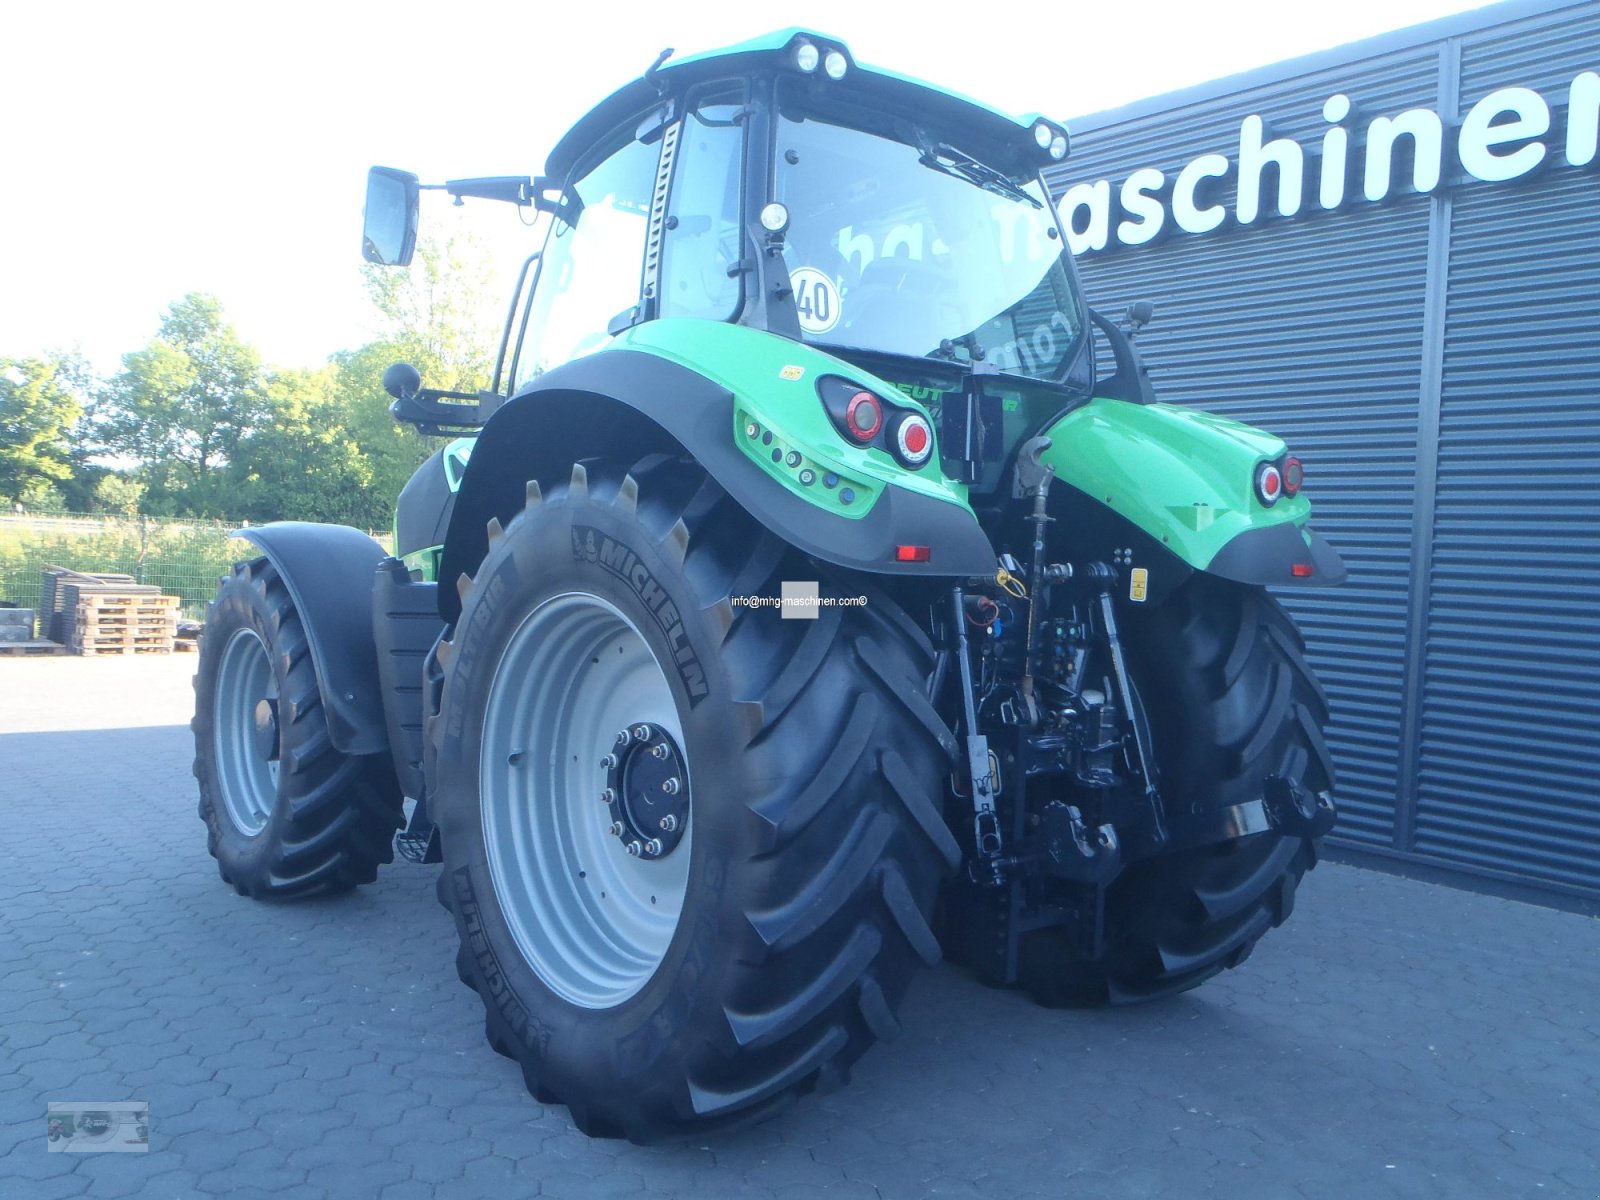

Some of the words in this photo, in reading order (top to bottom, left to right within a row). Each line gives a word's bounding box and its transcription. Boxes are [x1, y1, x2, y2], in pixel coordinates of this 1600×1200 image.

[796, 279, 830, 322] 40
[600, 536, 708, 699] MICHELIN
[455, 872, 529, 1037] MICHELIN
